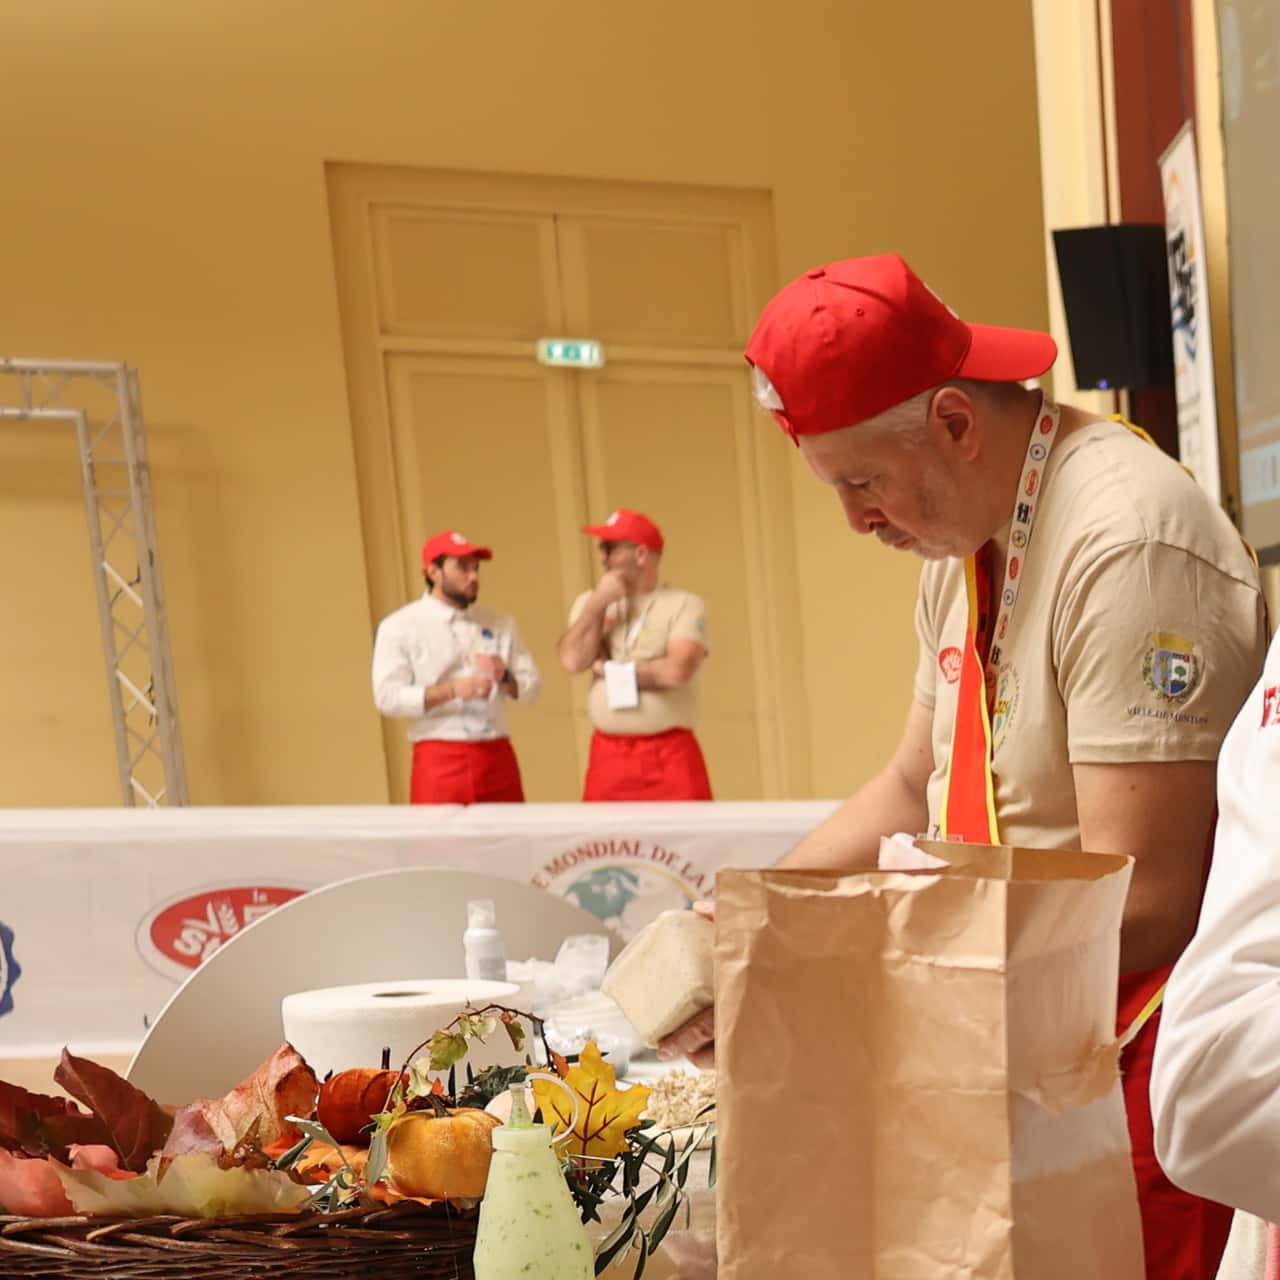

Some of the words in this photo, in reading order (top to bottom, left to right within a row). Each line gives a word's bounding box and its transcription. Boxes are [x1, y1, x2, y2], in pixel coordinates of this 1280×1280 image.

[544, 838, 645, 876] MONDIAL
[651, 844, 681, 867] DE
[680, 861, 706, 888] LA
